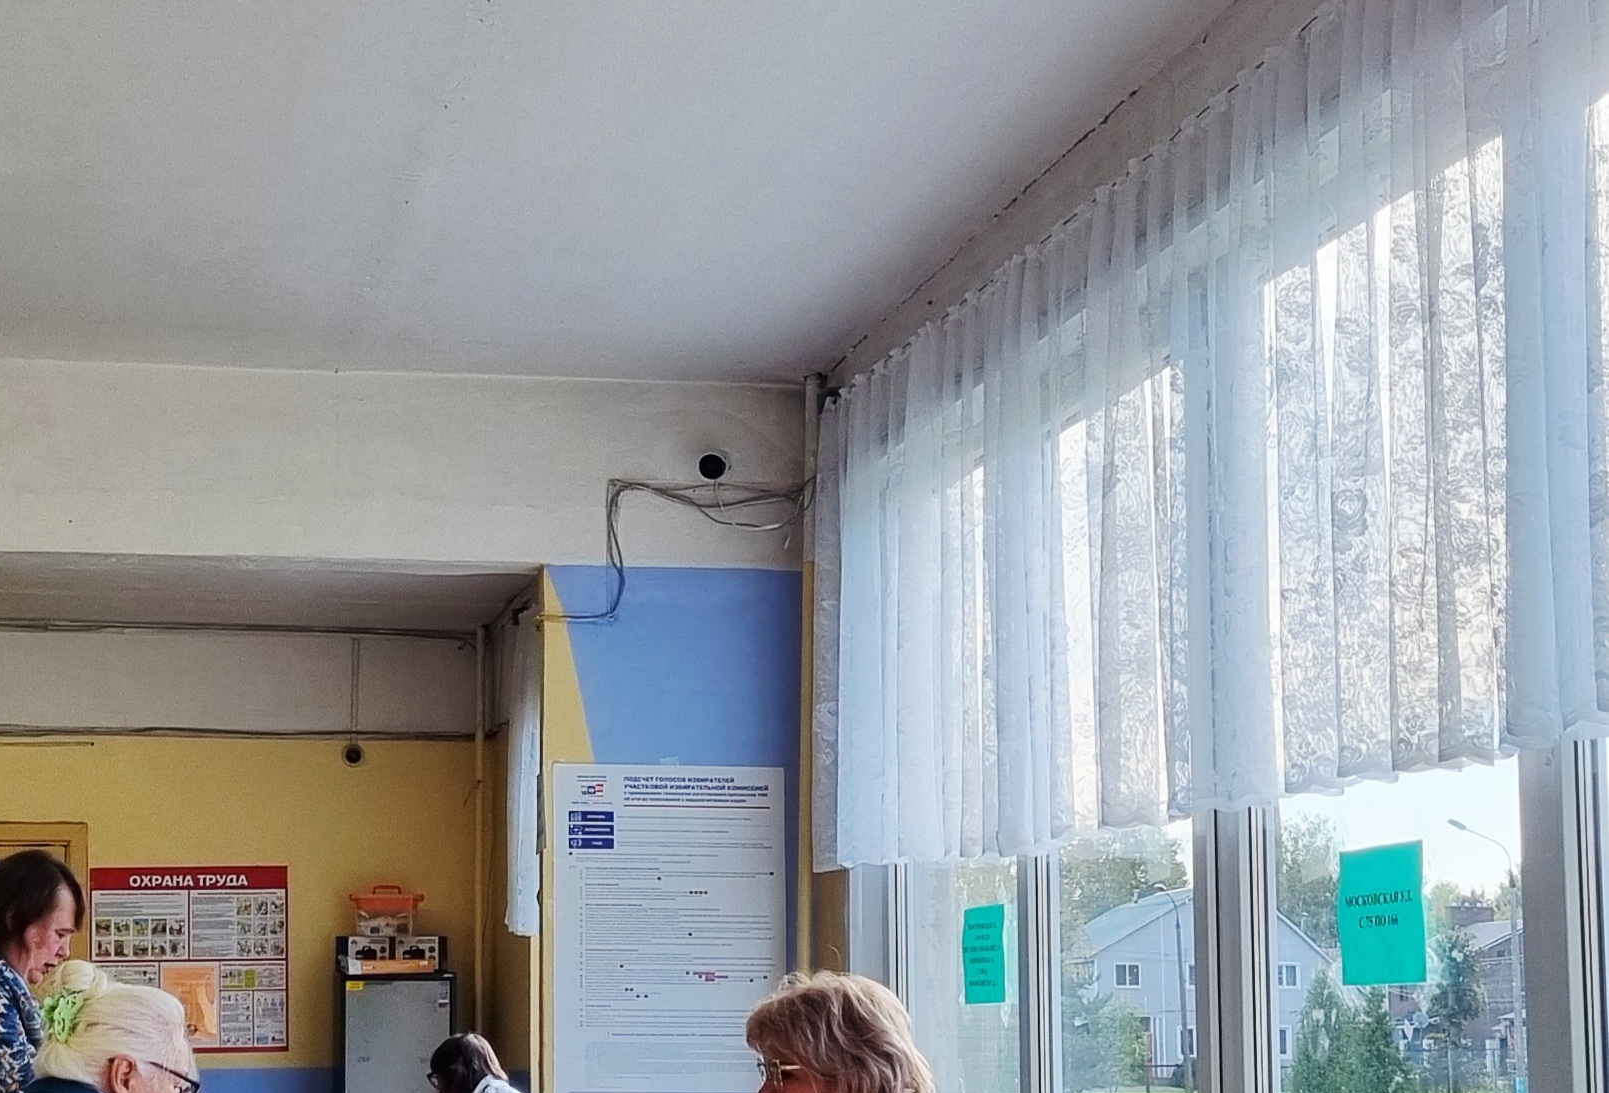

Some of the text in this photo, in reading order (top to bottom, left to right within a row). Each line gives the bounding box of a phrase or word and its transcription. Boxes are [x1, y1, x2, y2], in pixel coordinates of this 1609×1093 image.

[688, 776, 735, 784] ИЗБИРАТЕЛЕЙ
[129, 874, 249, 888] ОХРАНА ТРУДА
[1345, 890, 1399, 907] МОСКОВСКАЯ
